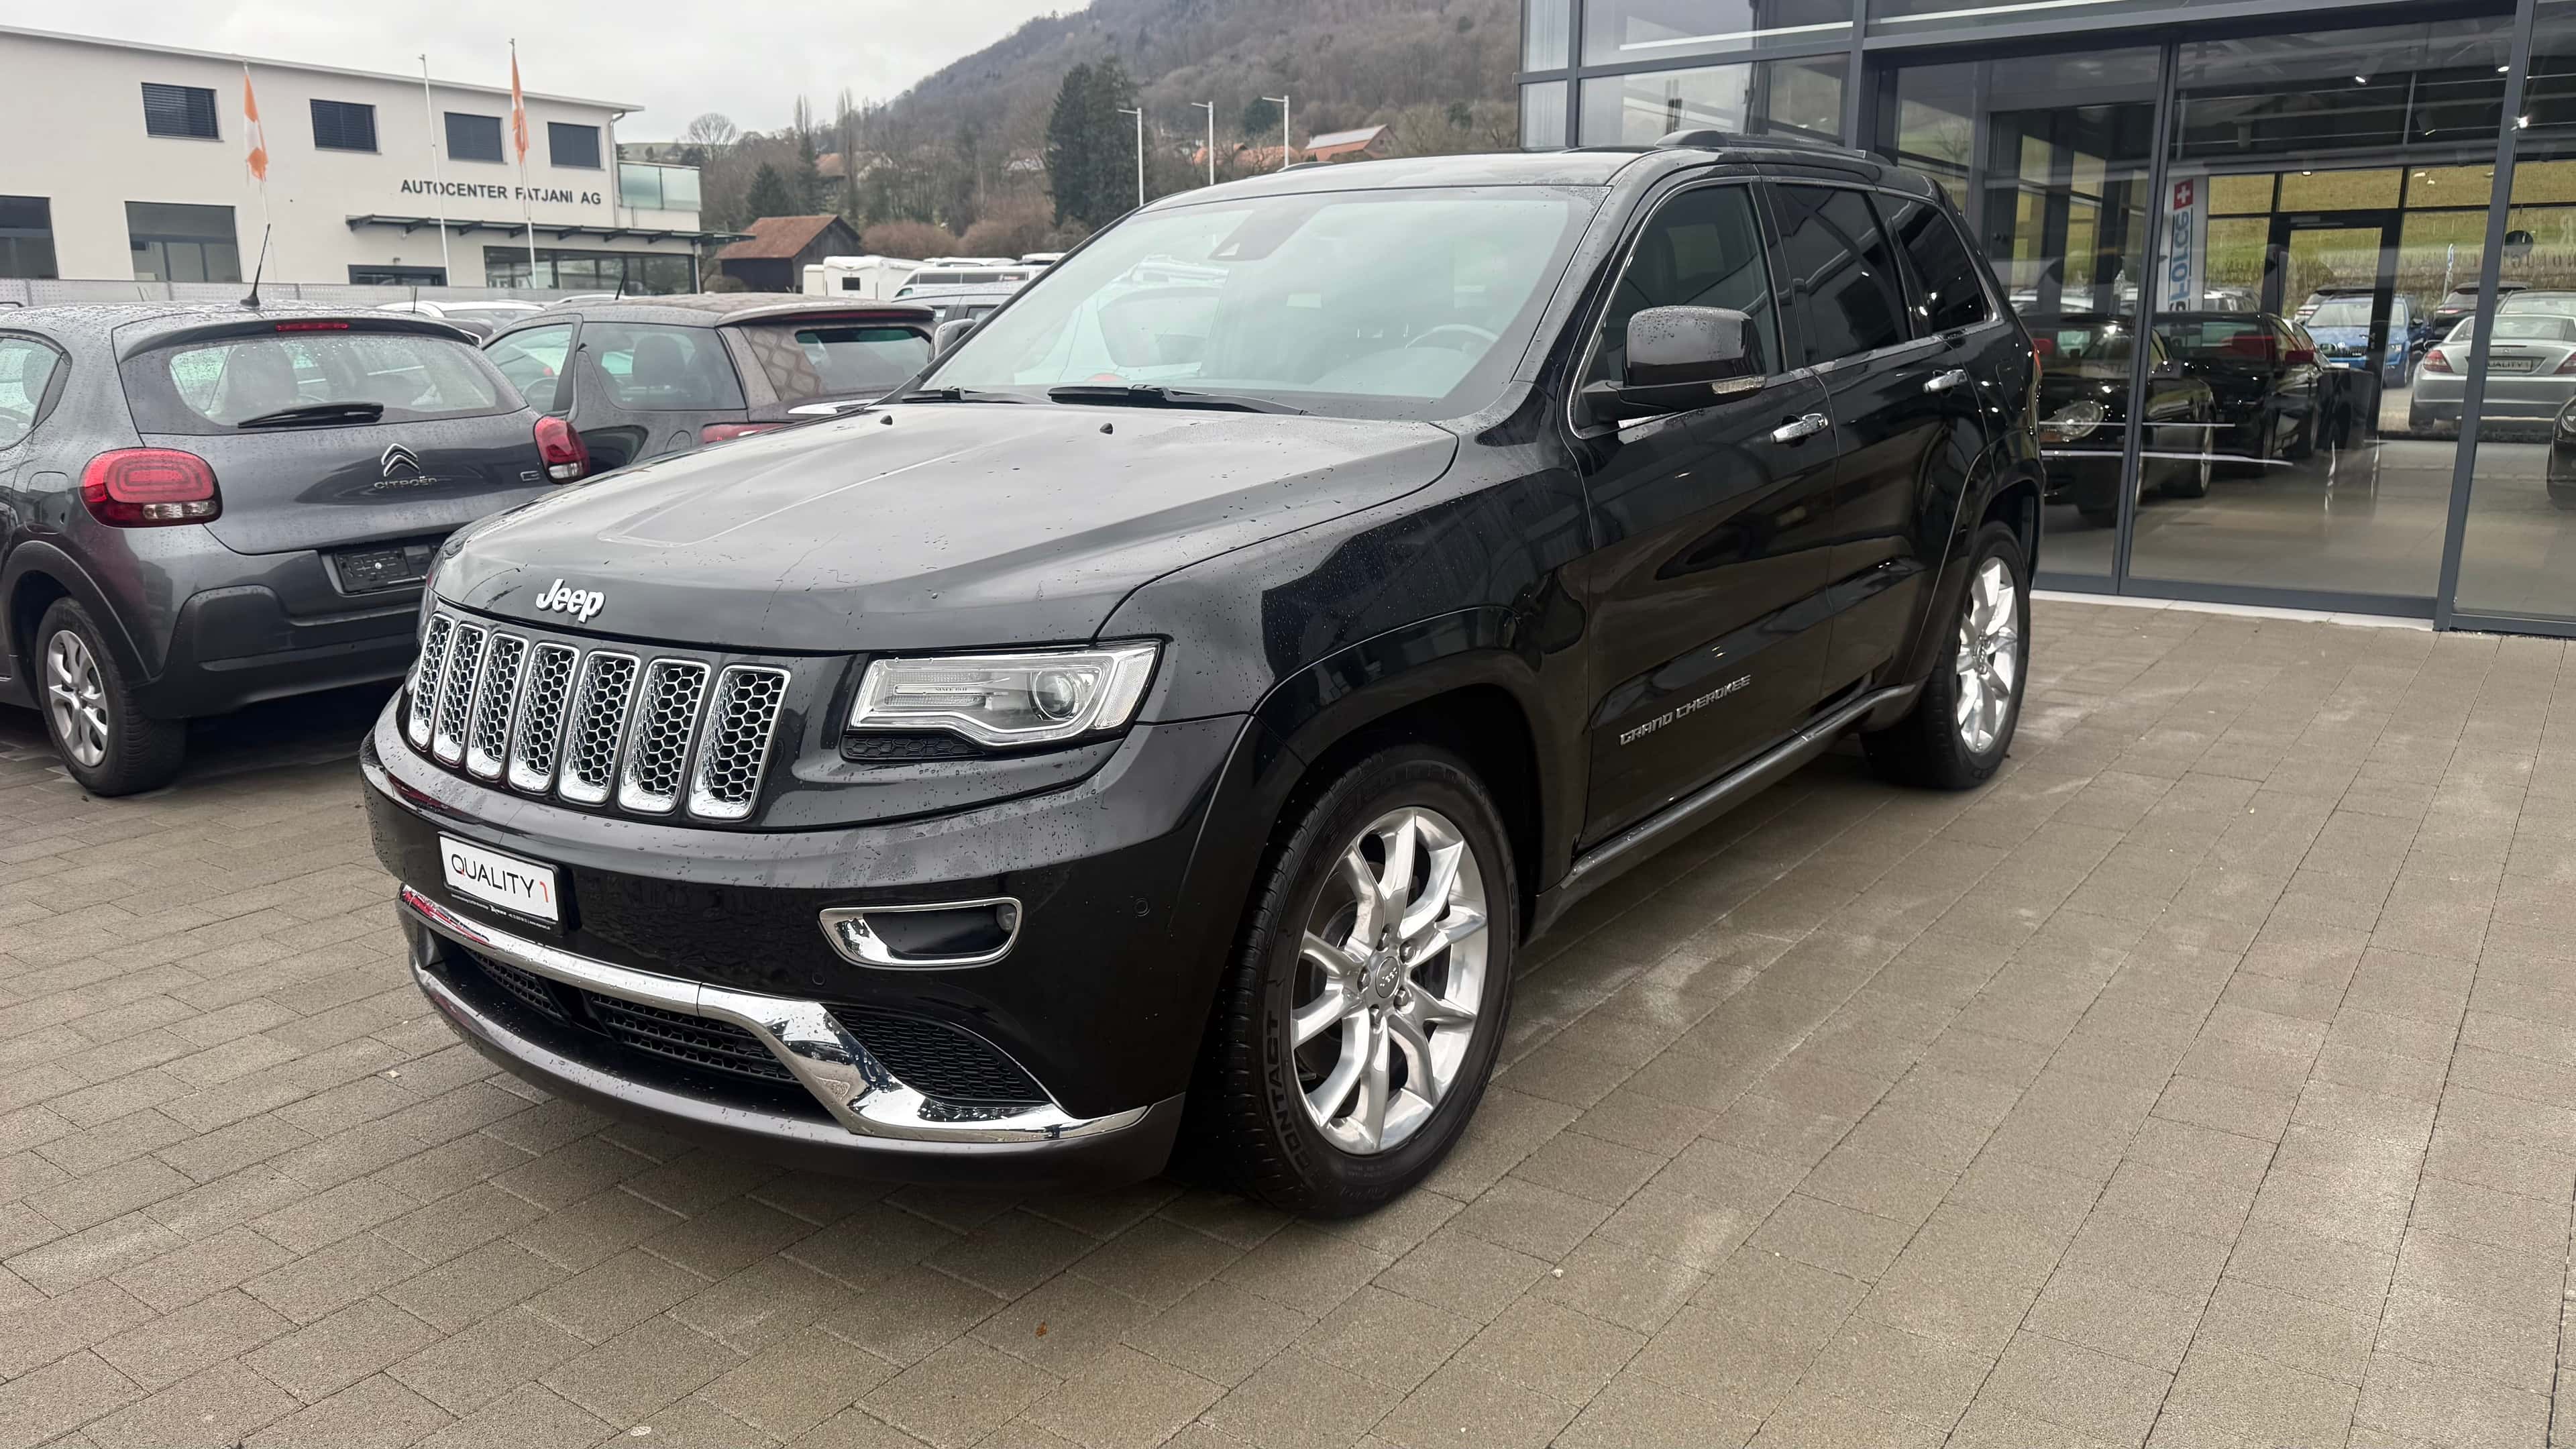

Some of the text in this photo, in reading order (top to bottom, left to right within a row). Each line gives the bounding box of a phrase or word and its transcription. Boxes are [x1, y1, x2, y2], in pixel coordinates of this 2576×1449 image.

[400, 179, 602, 205] AUTOCENTER FATJANI AG
[536, 578, 606, 623] Jeep
[1620, 674, 1752, 746] GRAND CHEROKEE
[451, 853, 549, 903] QUALITY 1
